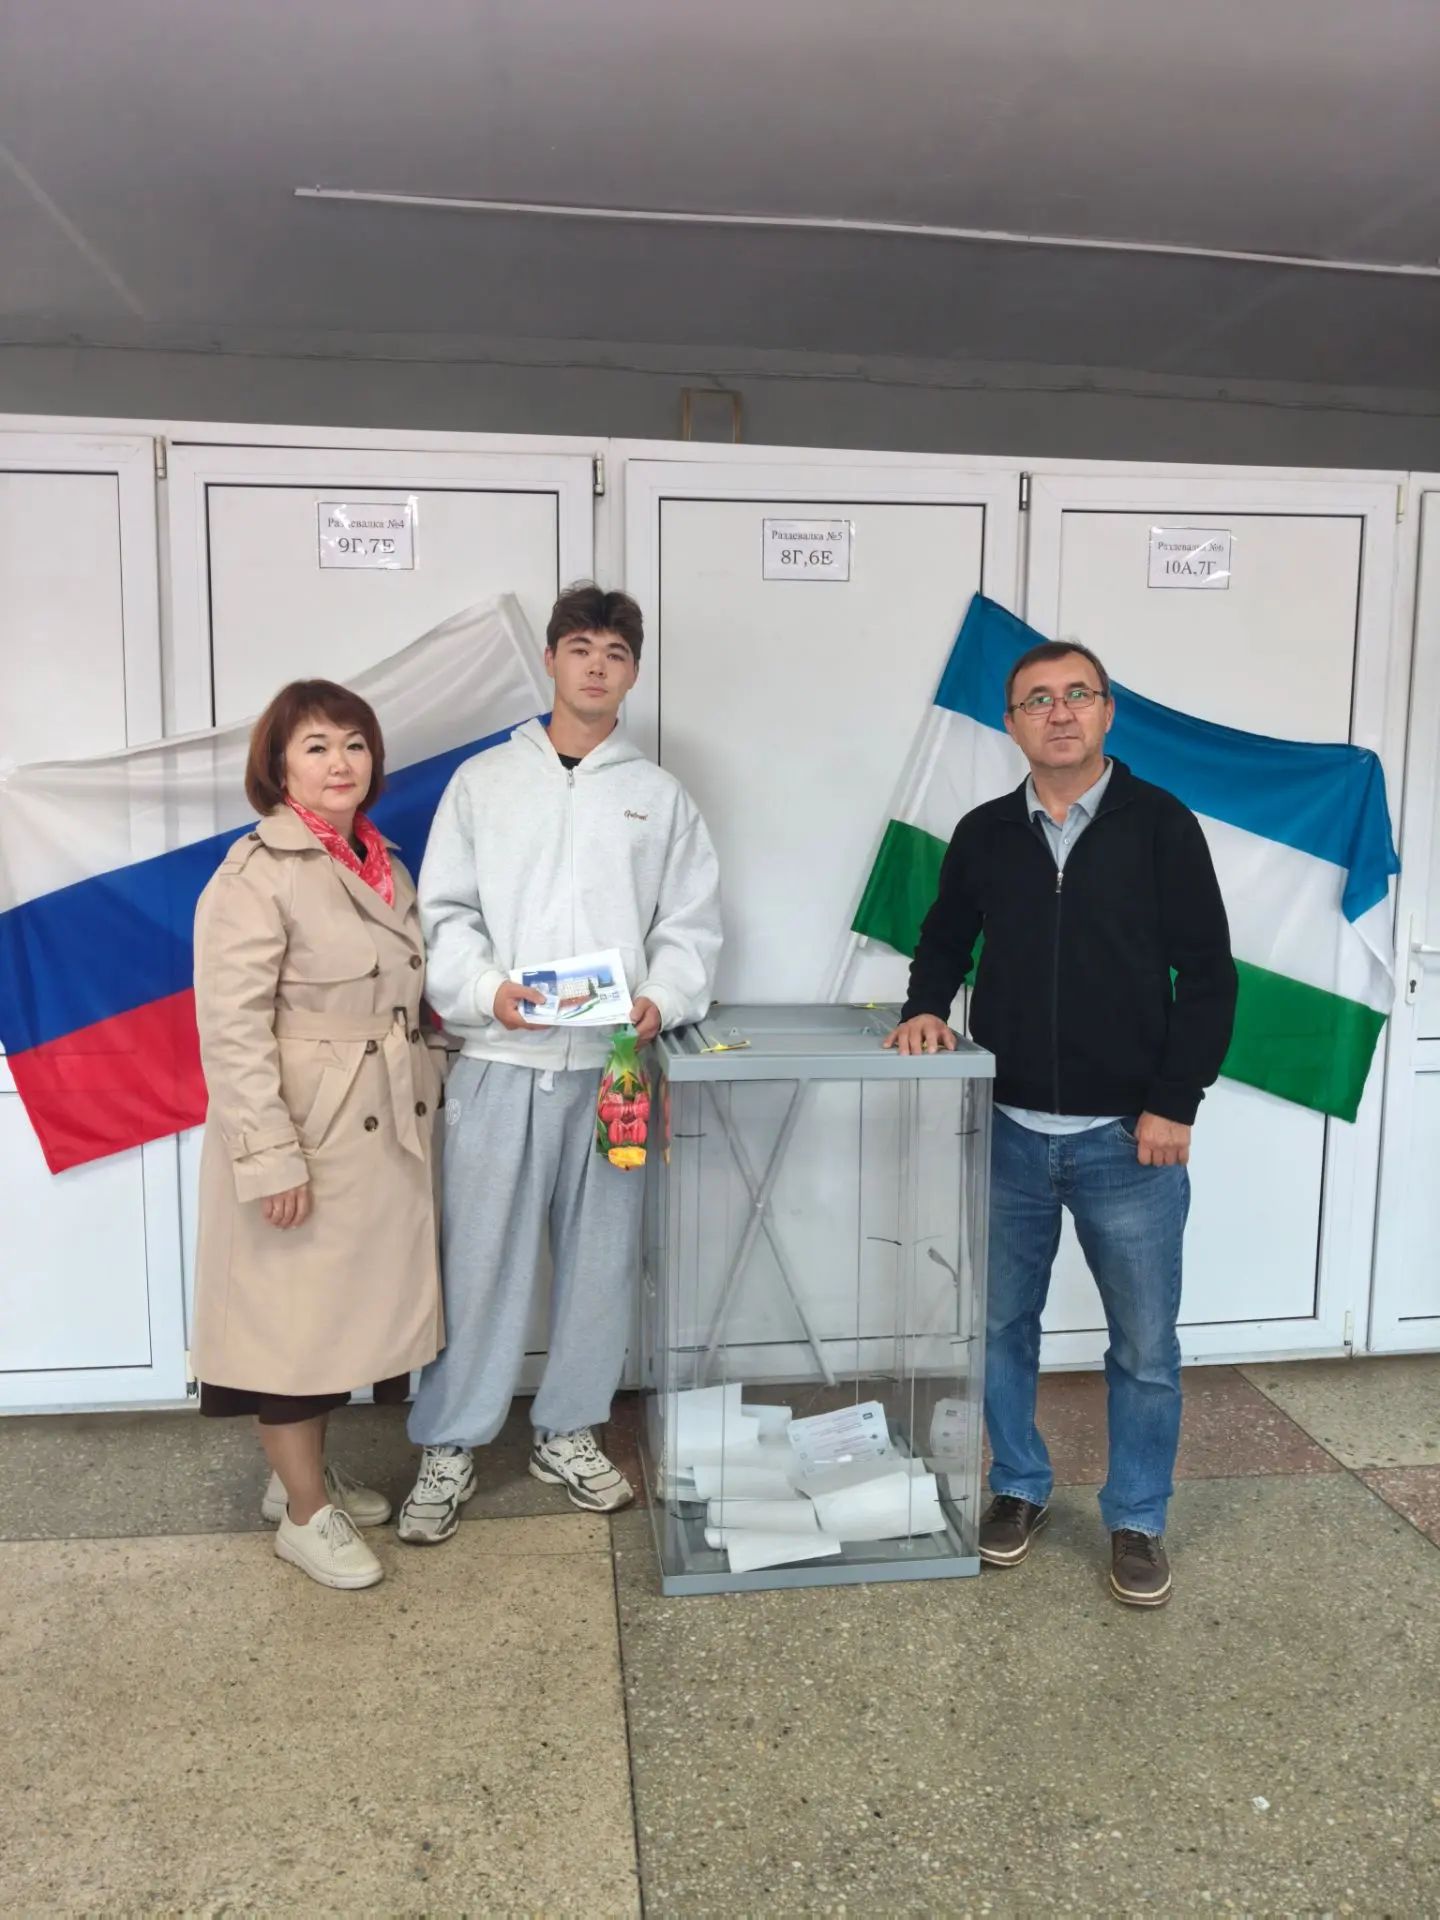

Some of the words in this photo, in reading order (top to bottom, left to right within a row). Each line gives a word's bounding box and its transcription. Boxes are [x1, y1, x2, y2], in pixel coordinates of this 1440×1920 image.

[328, 517, 384, 529] Разевалка
[387, 519, 405, 529] №4
[827, 531, 843, 541] №5
[338, 537, 395, 555] 9Г,7Е
[781, 549, 833, 567] 8Г,6Е
